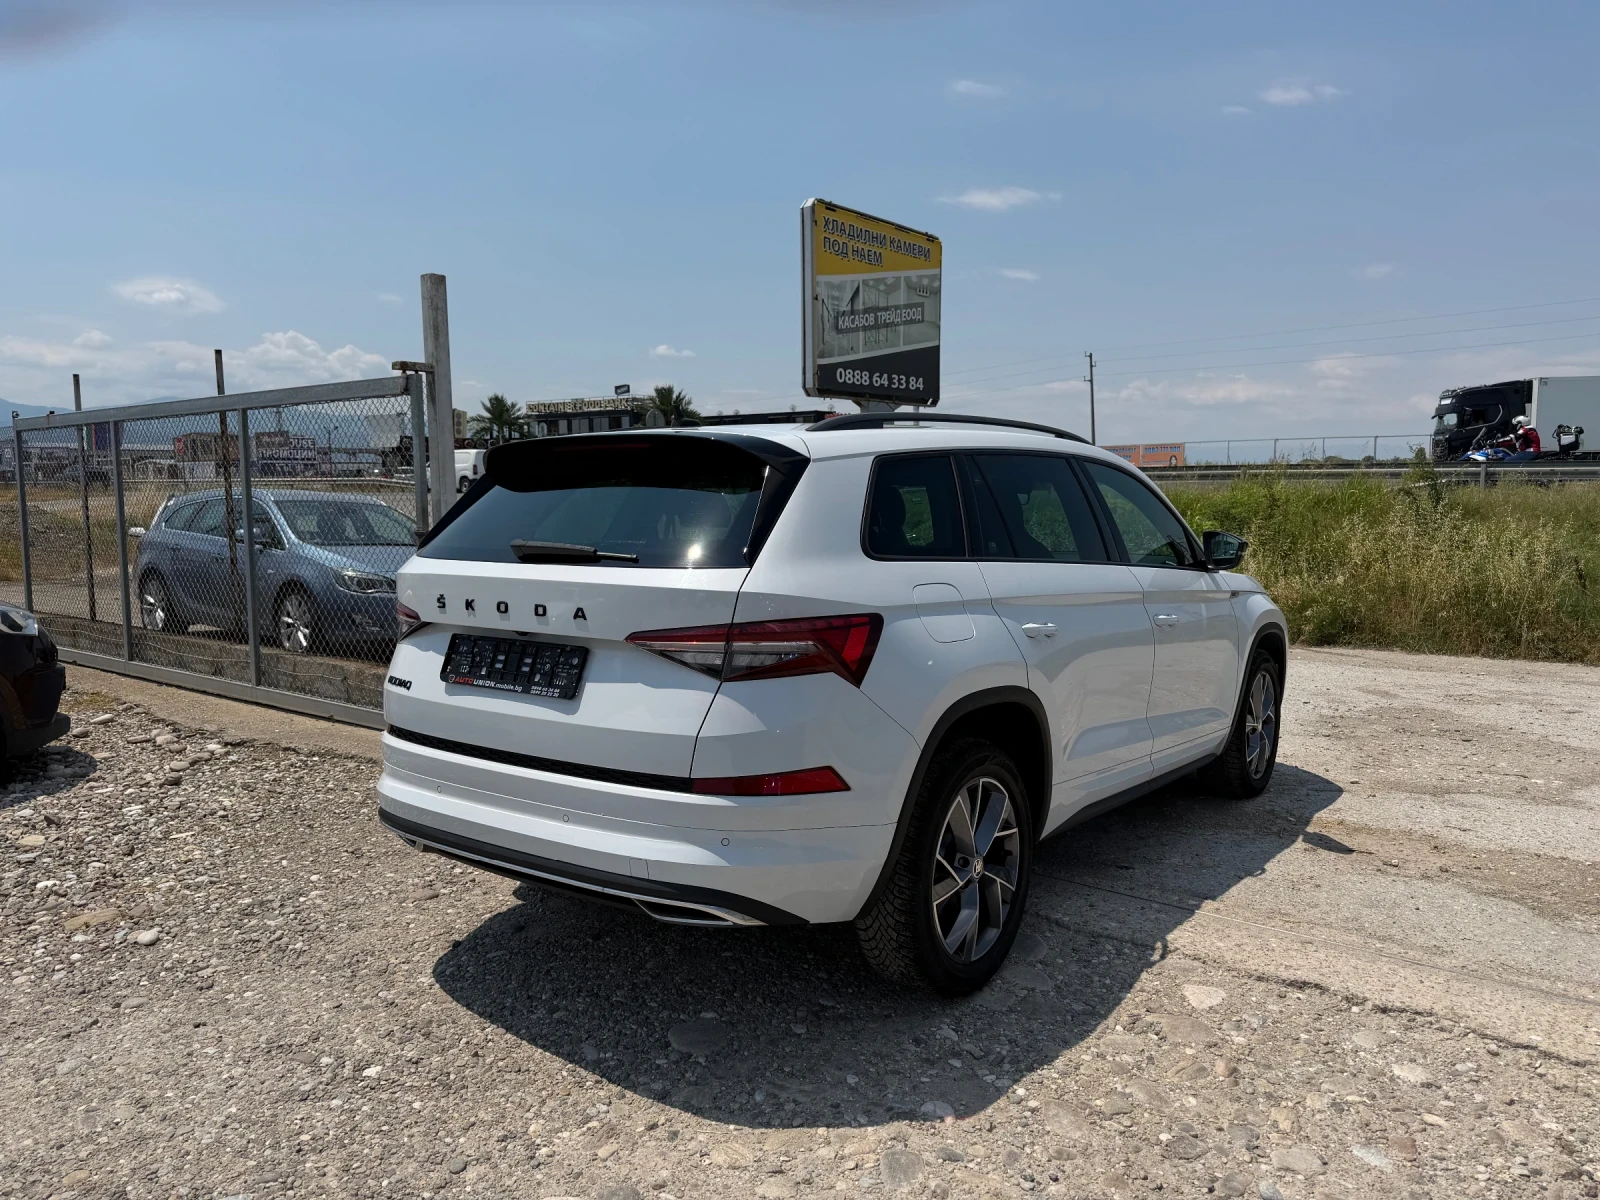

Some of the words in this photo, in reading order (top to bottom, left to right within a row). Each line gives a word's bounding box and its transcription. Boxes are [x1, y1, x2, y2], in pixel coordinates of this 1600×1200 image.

[823, 215, 887, 248] ХЛАДИЛНИ
[889, 235, 931, 260] КАМЕРИ
[823, 236, 849, 259] ПОД
[851, 244, 883, 265] НАЕМ
[838, 313, 875, 330] КАСАБОВ
[877, 308, 900, 324] ТРЕЙД
[901, 307, 922, 321] ЕООД
[836, 367, 870, 386] 0888
[872, 372, 889, 388] 64
[891, 374, 906, 389] 33
[909, 376, 924, 391] 84
[528, 401, 575, 413] CONTAINER
[576, 399, 601, 412] FOOD
[603, 398, 628, 410] PARK
[258, 447, 315, 459] ПРОМОЦИИ
[436, 594, 587, 621] ŠKODA
